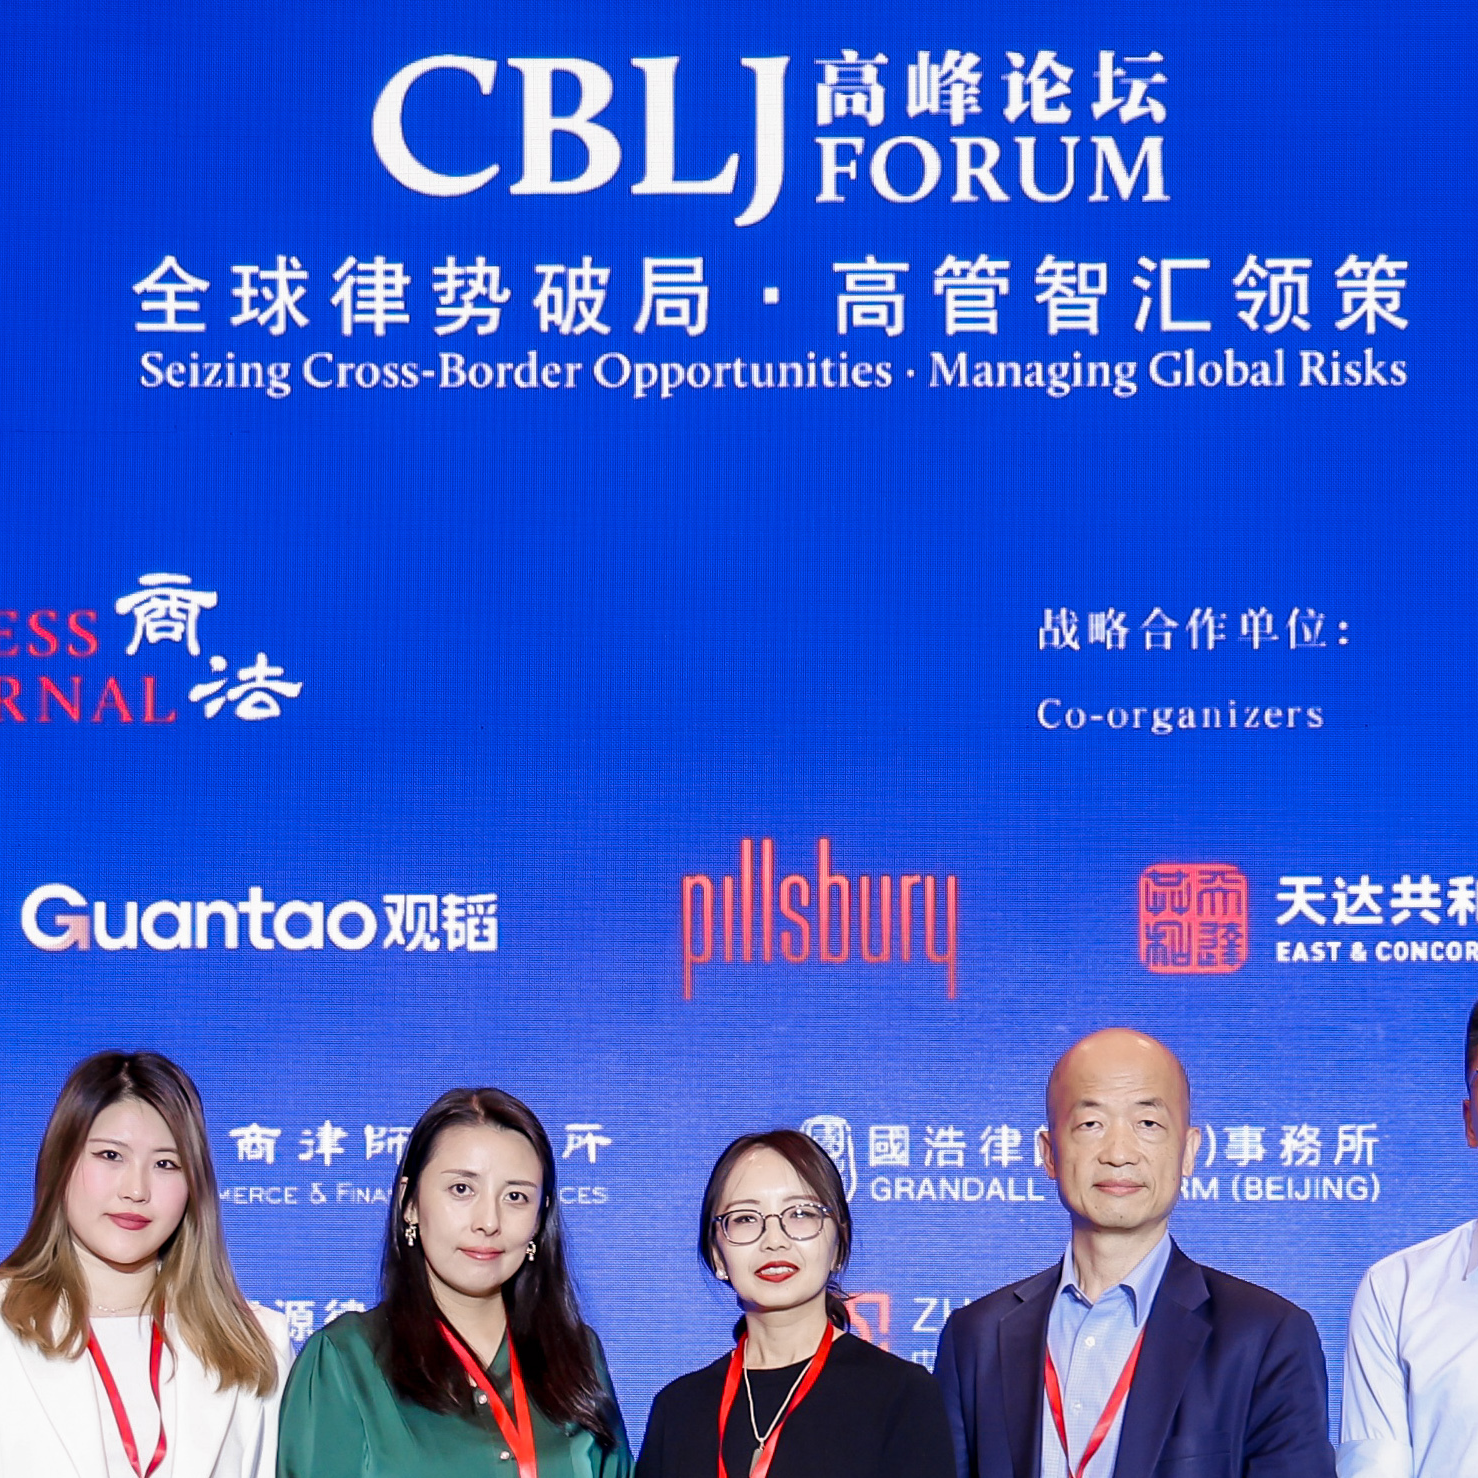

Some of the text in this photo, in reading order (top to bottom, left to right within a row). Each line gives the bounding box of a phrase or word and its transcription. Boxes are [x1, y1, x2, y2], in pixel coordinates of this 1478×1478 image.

[815, 48, 1168, 128] 高峰论坛
[371, 54, 791, 227] CBLJ
[814, 135, 1171, 203] FORUM
[140, 347, 1407, 400] Seizing Cross-Border Opportunities Managing Global Risks
[1037, 698, 1324, 735] Co-organizers
[682, 836, 960, 1000] pillsbury
[1275, 941, 1341, 964] EAST
[1349, 941, 1368, 963] &
[869, 1176, 1047, 1202] GRANDALL
[1231, 1172, 1381, 1203] (BEIJING)
